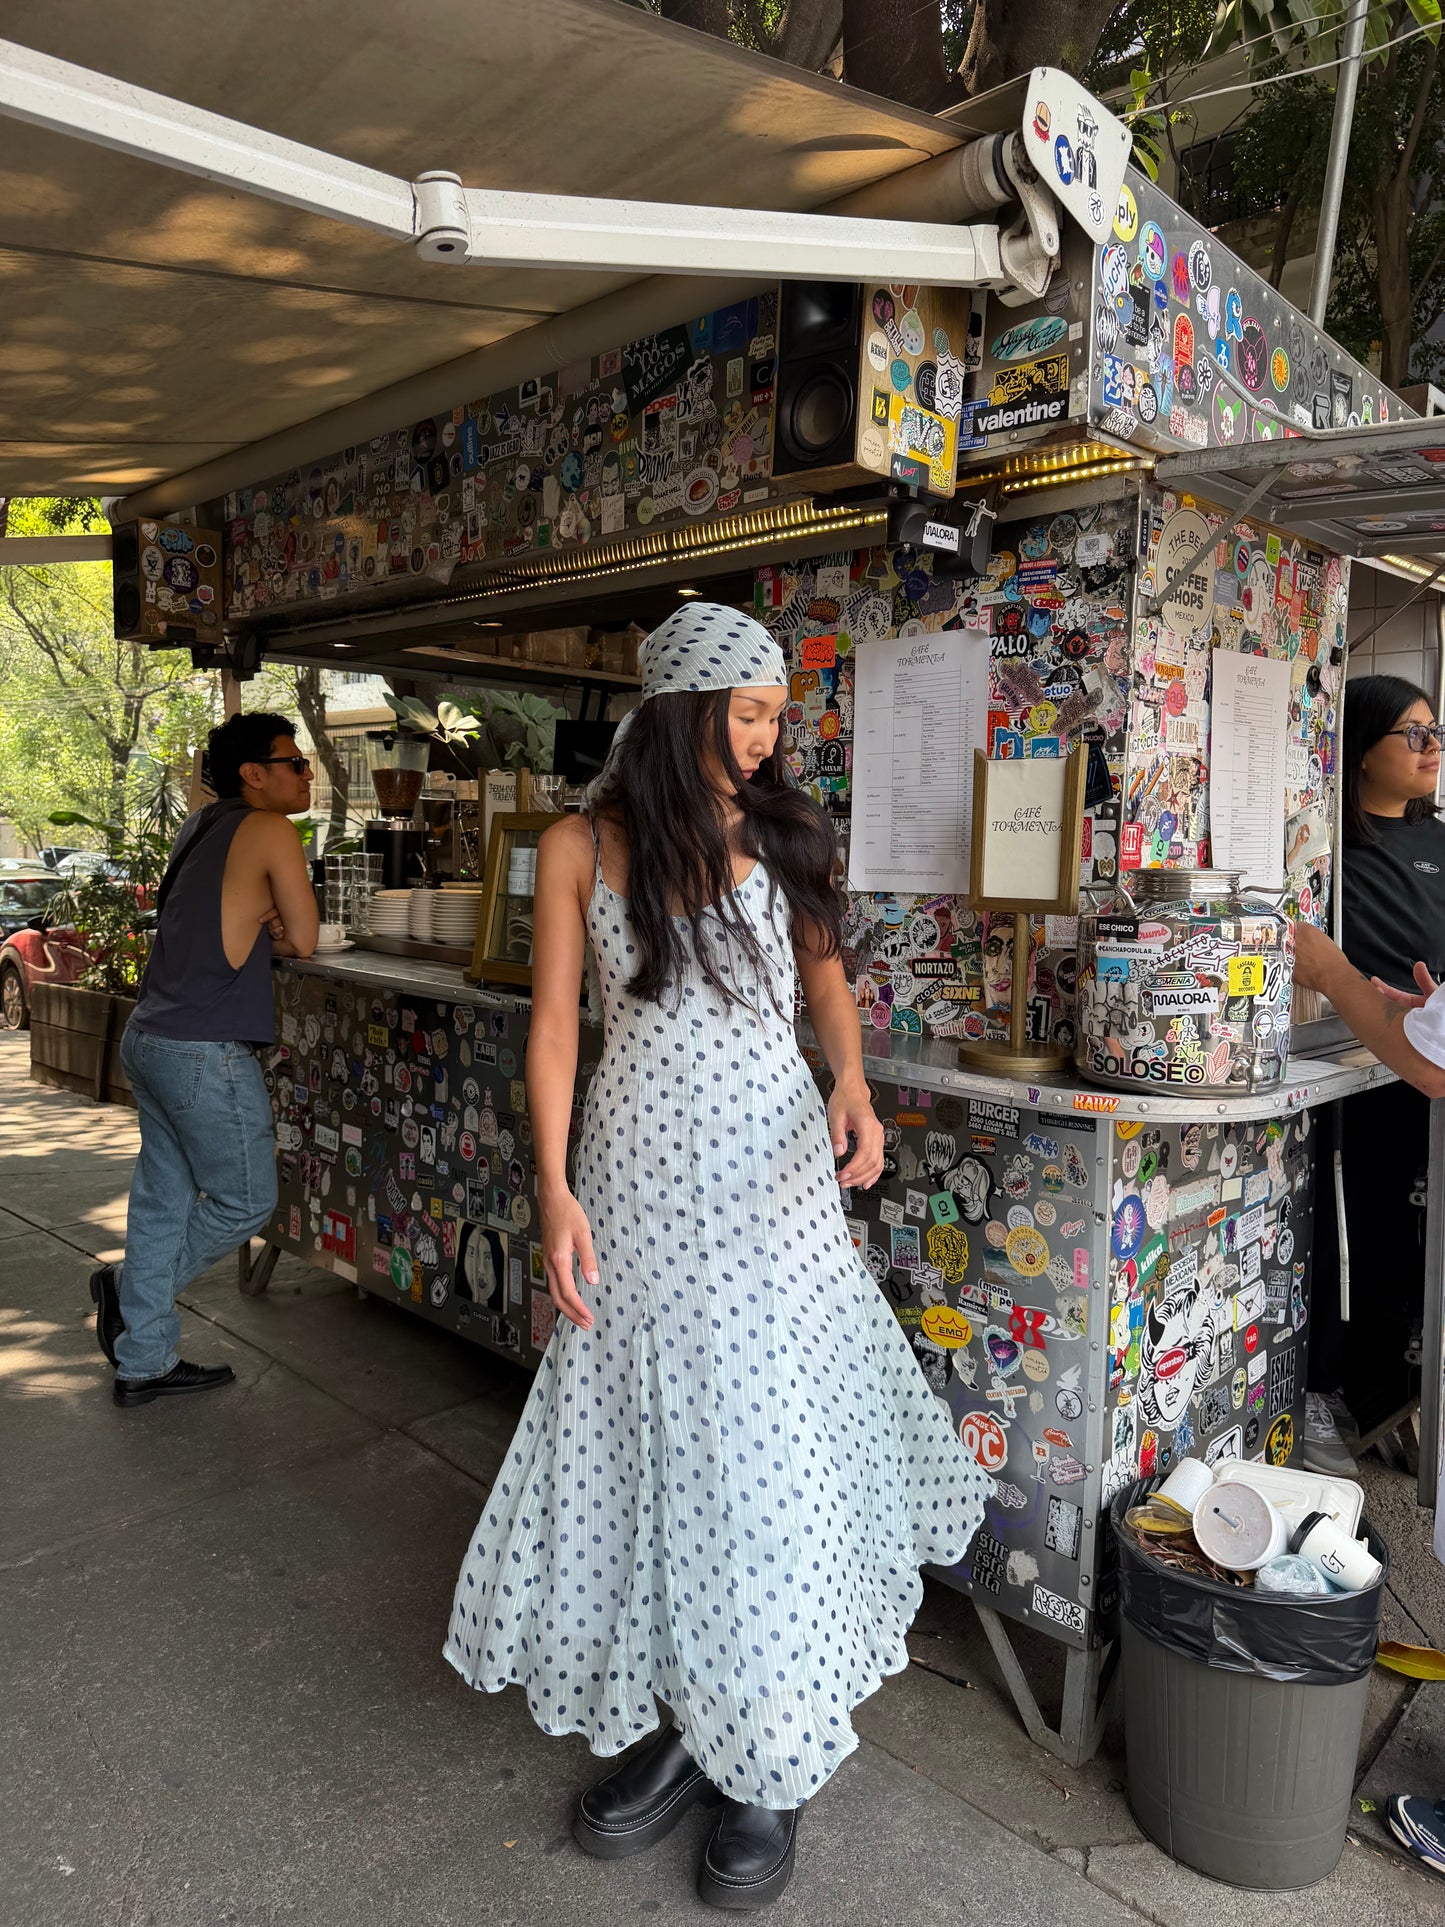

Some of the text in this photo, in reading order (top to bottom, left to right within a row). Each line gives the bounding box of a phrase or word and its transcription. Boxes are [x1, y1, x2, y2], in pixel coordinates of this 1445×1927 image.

[1114, 201, 1136, 229] ply
[1168, 530, 1187, 549] THE
[1165, 566, 1208, 593] CFEE
[1168, 589, 1204, 610] SHOPS
[1174, 610, 1195, 623] MEXICO
[990, 633, 1029, 657] PALO
[897, 652, 946, 667] TORMENTA
[1014, 806, 1042, 821] CAFÉ
[991, 820, 1063, 835] TORMENTA
[1099, 923, 1135, 933] ESE CHICO
[914, 961, 955, 975] NORTAZO
[916, 979, 944, 1004] CLOSER
[969, 1099, 1020, 1124] BURGER
[968, 1121, 982, 1130] 3460
[969, 1116, 1018, 1132] 2060 LOGAN AVE.
[1165, 1263, 1197, 1287] MEXICANA
[938, 1326, 963, 1338] EMO
[1246, 1333, 1257, 1345] TAG
[969, 1414, 989, 1431] MADE
[963, 1424, 1001, 1466] OC
